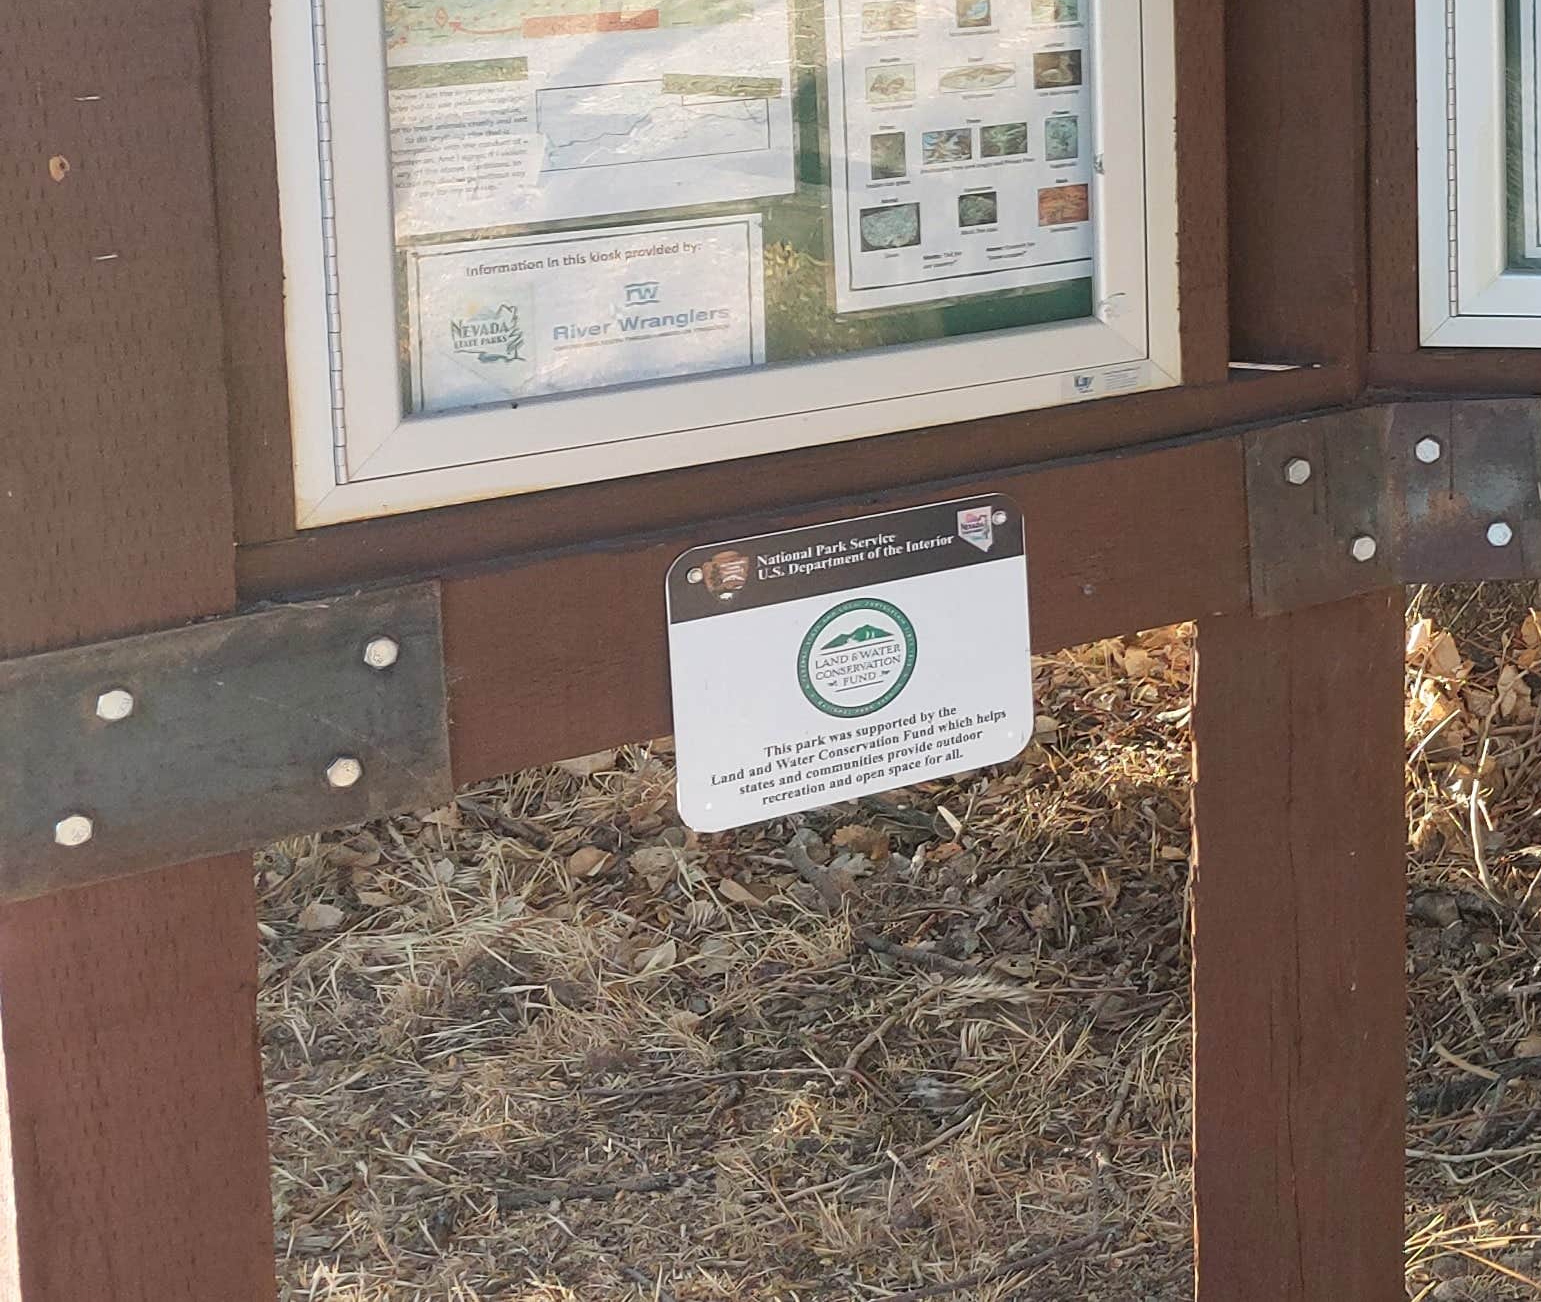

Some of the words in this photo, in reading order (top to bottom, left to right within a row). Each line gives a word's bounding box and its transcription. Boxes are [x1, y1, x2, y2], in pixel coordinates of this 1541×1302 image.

[466, 259, 544, 277] Information
[547, 258, 560, 269] in
[563, 255, 586, 267] this
[590, 249, 621, 264] kiosk
[624, 243, 679, 261] provided
[682, 241, 702, 254] by:
[451, 320, 510, 340] NEVADA
[480, 335, 507, 346] PARKS
[552, 323, 611, 341] River
[617, 308, 730, 332] Wranglers
[757, 546, 812, 566] National
[815, 540, 846, 556] Park
[849, 533, 895, 549] Service
[757, 565, 785, 580] U.S.
[788, 552, 864, 574] Department
[866, 546, 882, 559] of
[882, 544, 903, 557] the
[905, 535, 953, 552] Interior
[814, 654, 849, 669] LAND
[858, 643, 900, 658] WATER
[815, 654, 900, 680] CONSERVATION
[842, 671, 876, 686] FUND
[710, 768, 744, 786] Land
[748, 761, 772, 777] and
[775, 754, 815, 769] Water
[818, 735, 899, 760] Conservation
[903, 724, 934, 741] Fund
[937, 716, 973, 732] which
[976, 710, 1006, 724] helps
[763, 743, 792, 757] This
[795, 734, 826, 754] park
[828, 730, 852, 742] was
[855, 713, 916, 737] supported
[919, 711, 935, 724] by
[937, 706, 956, 718] the
[739, 779, 775, 794] states
[778, 770, 802, 785] and
[805, 753, 883, 778] communities
[887, 741, 932, 763] provide
[935, 730, 982, 748] outdoor
[762, 783, 825, 805] recreation
[829, 773, 852, 789] and
[855, 768, 884, 784] open
[887, 760, 921, 776] space
[924, 754, 943, 766] for
[944, 747, 963, 761] all.
